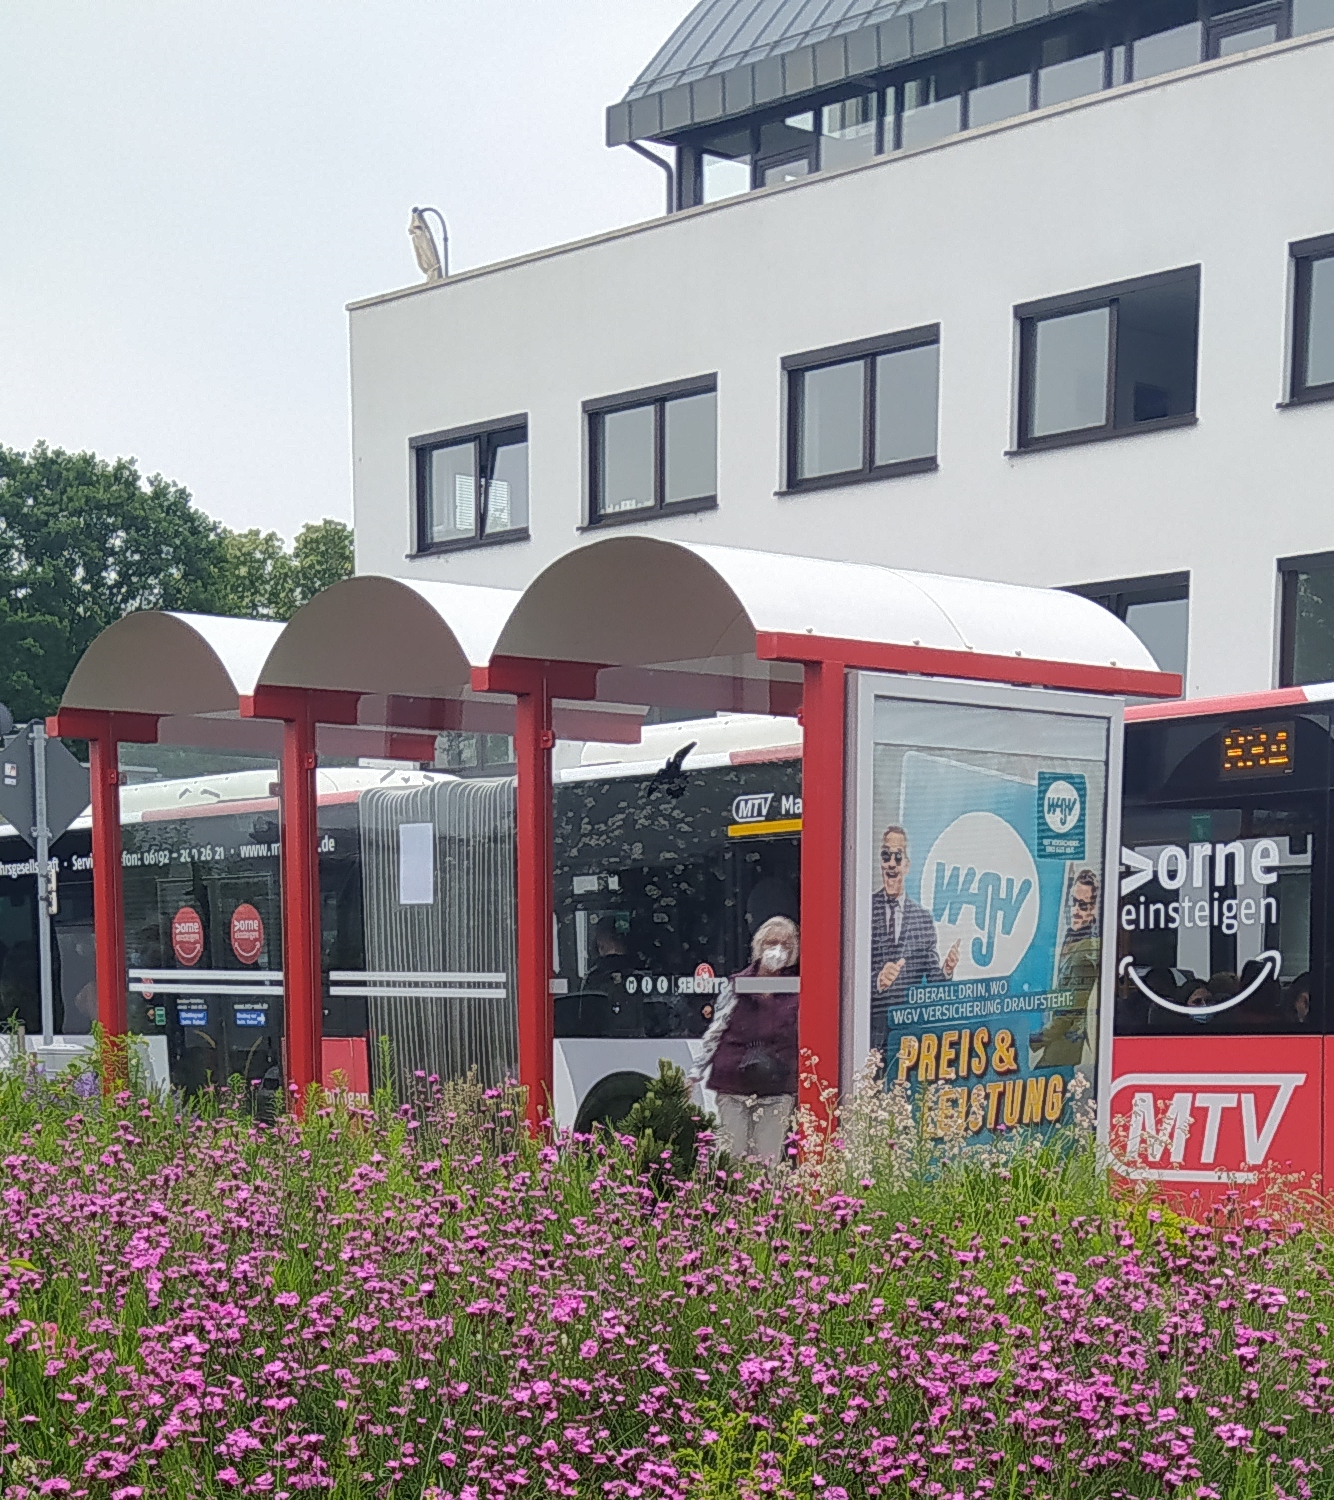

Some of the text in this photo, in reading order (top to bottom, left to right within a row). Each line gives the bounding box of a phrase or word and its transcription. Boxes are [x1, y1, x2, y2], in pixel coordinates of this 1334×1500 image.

[738, 798, 773, 818] MTV
[1121, 891, 1278, 935] einsteigen
[893, 991, 1074, 1025] WGV VERSICHERUNG DRAUFSTEHT:
[908, 979, 1008, 1004] ÜBERALL DRIN, WO
[1126, 1091, 1295, 1166] MTV
